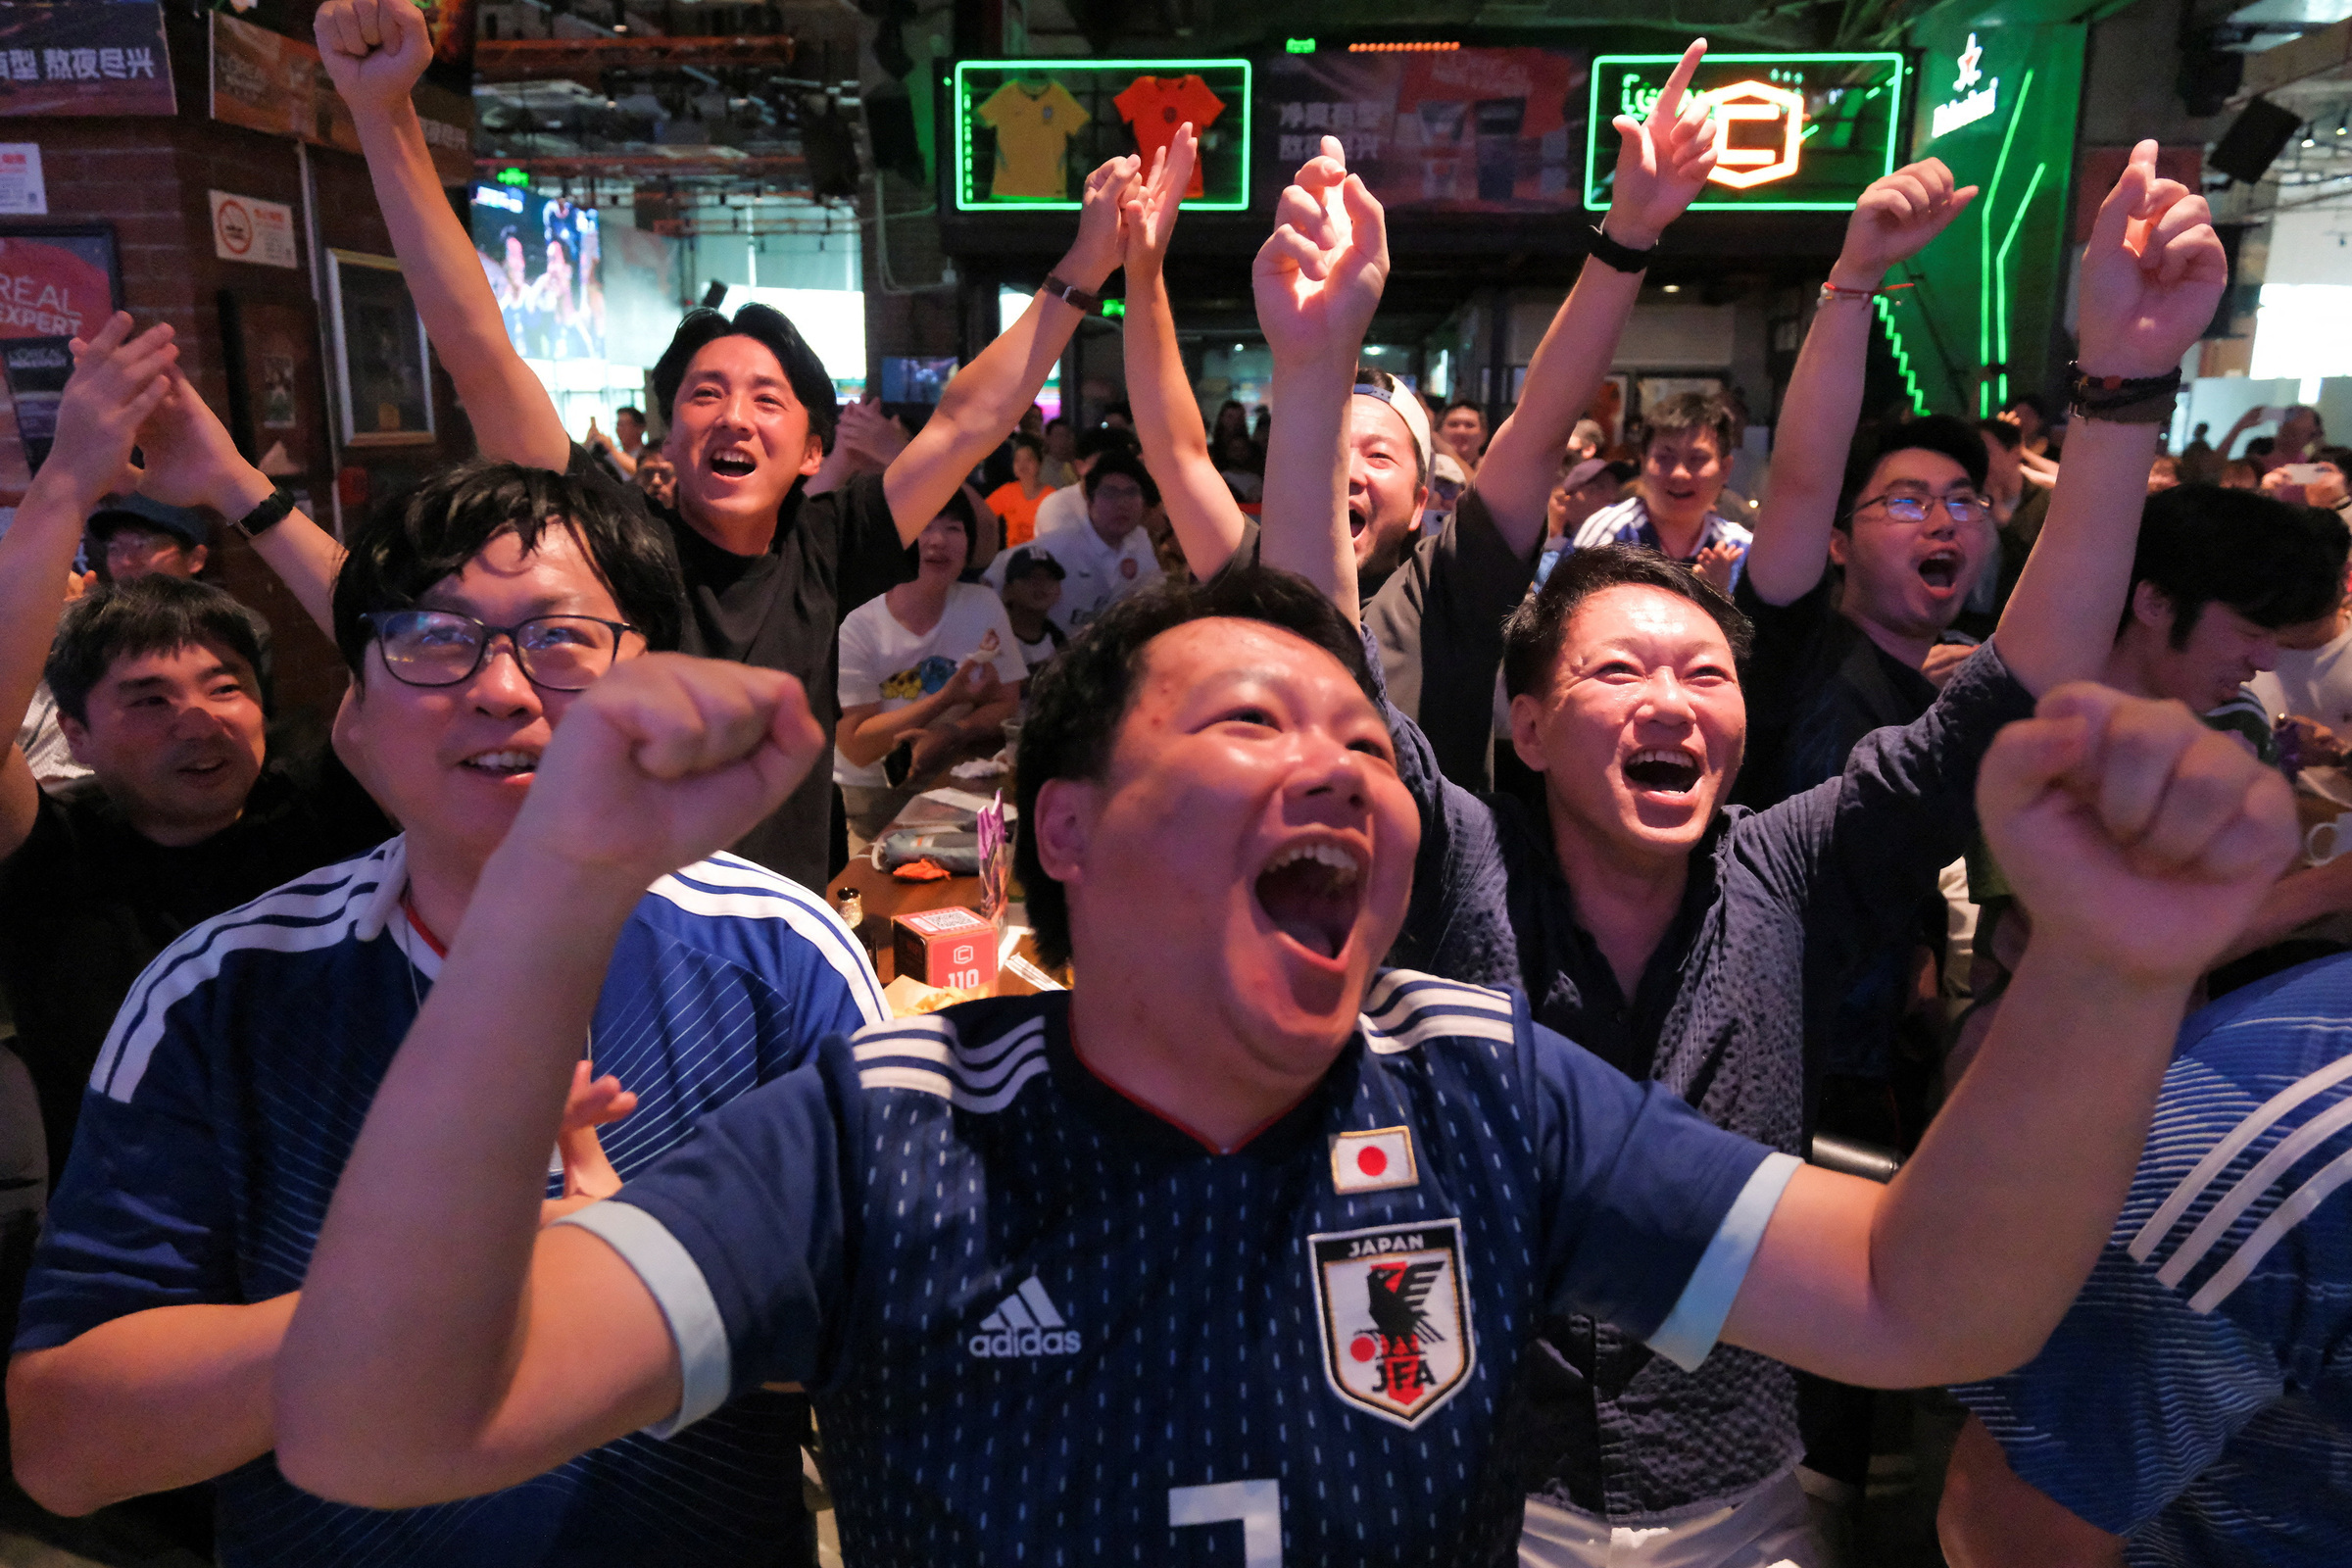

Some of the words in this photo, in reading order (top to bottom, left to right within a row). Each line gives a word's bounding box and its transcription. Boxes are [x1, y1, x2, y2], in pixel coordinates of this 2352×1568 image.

[1348, 1233, 1425, 1258] JAPAN
[968, 1326, 1082, 1358] adidas
[1371, 1358, 1438, 1393] JFA
